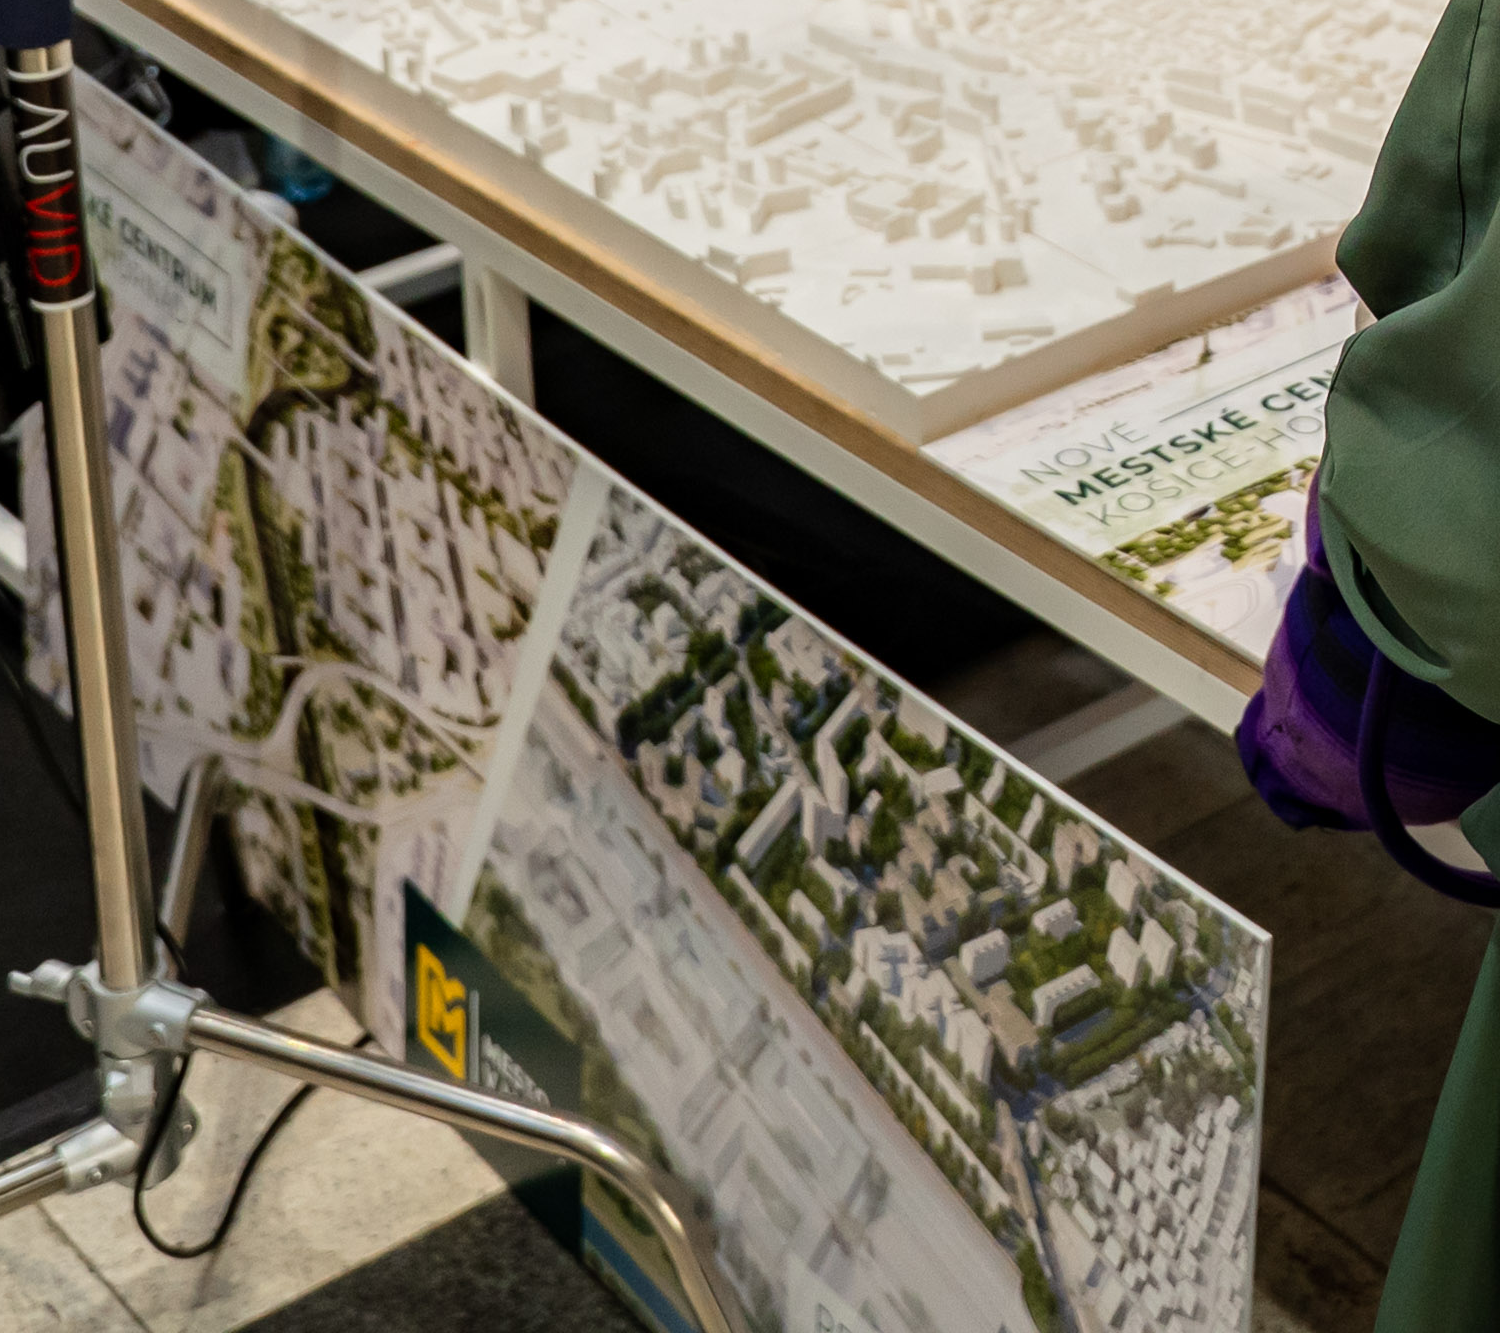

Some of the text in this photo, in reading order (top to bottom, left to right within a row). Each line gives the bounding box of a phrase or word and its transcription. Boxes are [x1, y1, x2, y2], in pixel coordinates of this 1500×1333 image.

[118, 214, 219, 316] CENTRUM
[1019, 419, 1150, 485] NOVÉ
[1052, 406, 1260, 507] MESTSKÉ
[1086, 403, 1326, 528] KOŠICE-HO
